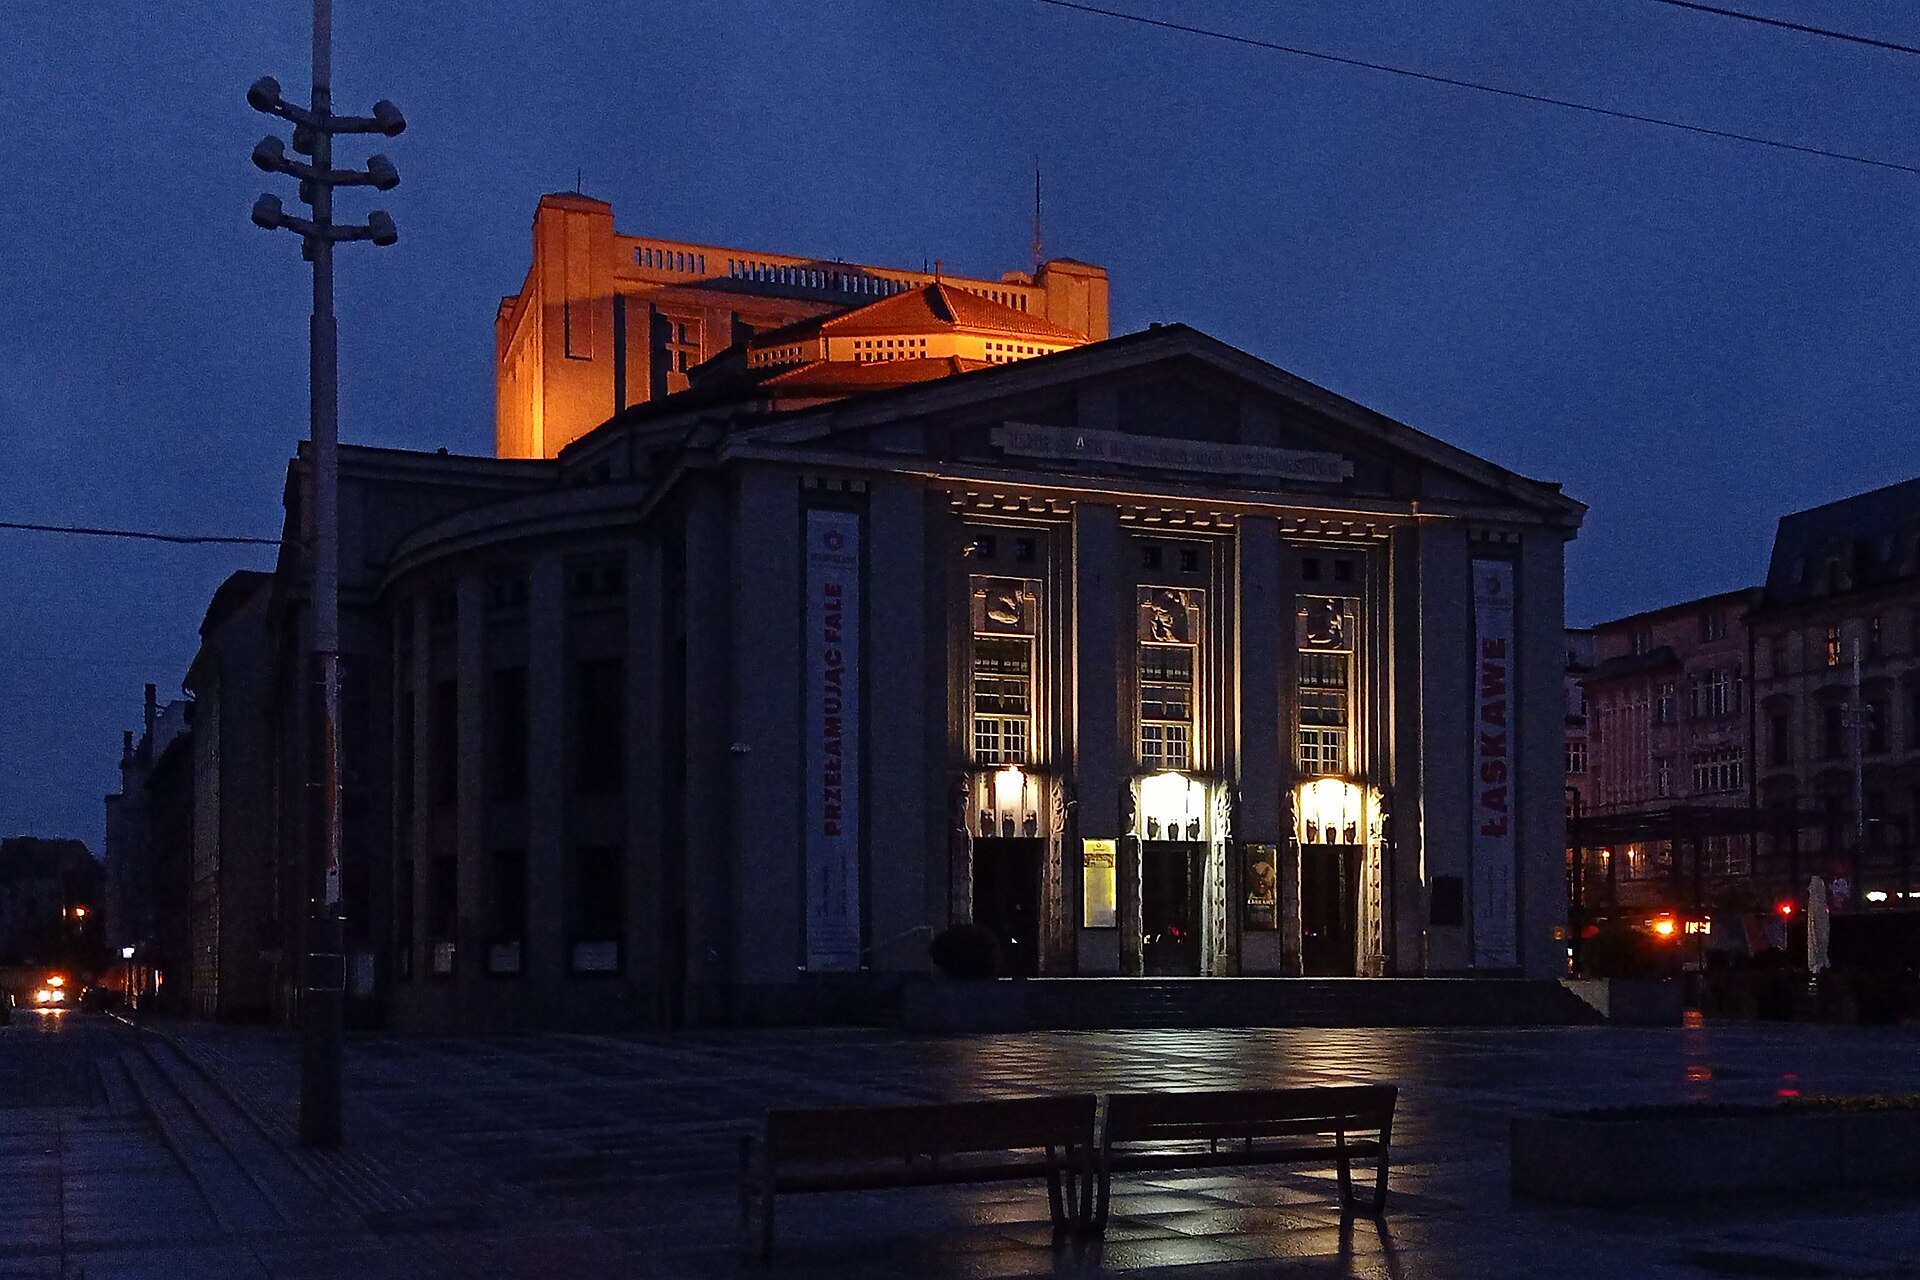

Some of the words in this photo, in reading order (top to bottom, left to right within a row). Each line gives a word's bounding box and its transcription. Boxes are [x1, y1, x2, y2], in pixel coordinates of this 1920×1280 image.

[824, 583, 842, 643] FALE
[824, 650, 844, 836] PRZEŁAMUJĄC
[1481, 638, 1507, 836] ŁASKAWE
